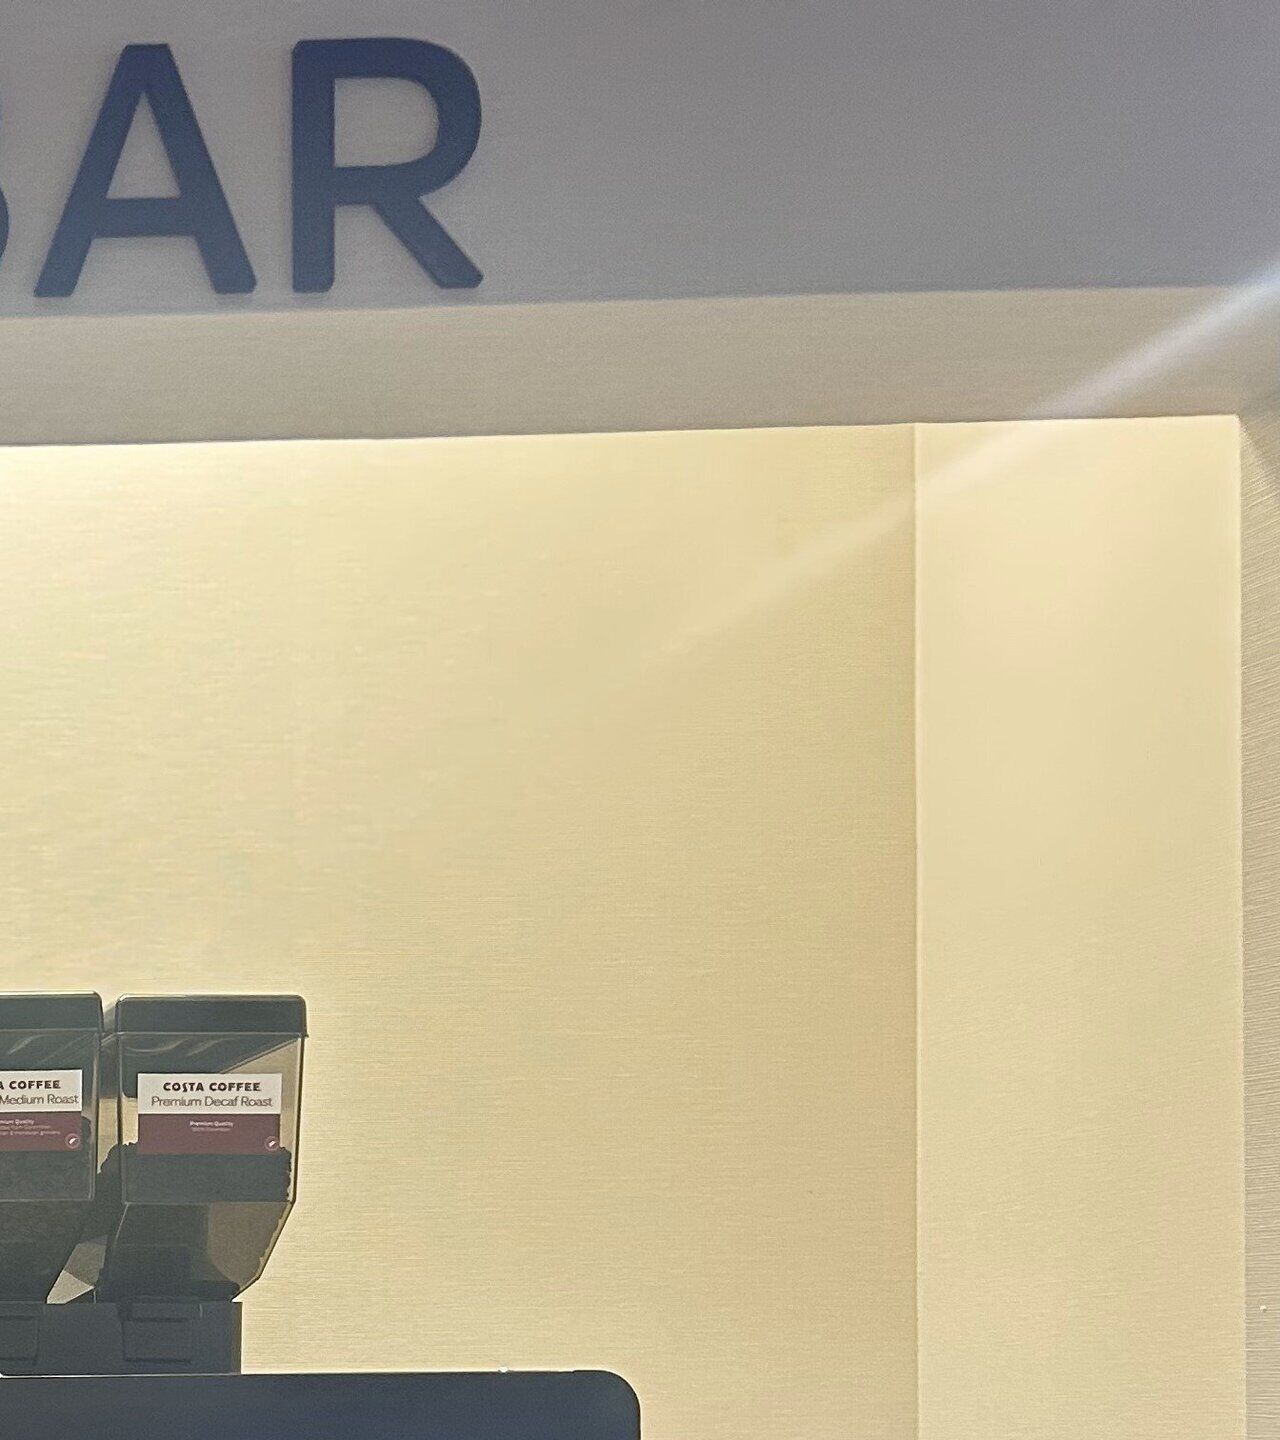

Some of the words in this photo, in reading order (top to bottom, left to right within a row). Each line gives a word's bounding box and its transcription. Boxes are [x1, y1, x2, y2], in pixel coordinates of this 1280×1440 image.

[9, 1080, 61, 1090] COFFEE
[163, 1082, 204, 1092] COSTA
[209, 1082, 262, 1092] COFFEE
[0, 1094, 44, 1105] Medium
[47, 1093, 79, 1104] Roast
[151, 1095, 202, 1107] Premium
[204, 1095, 239, 1107] Decaf
[241, 1095, 273, 1107] Roast
